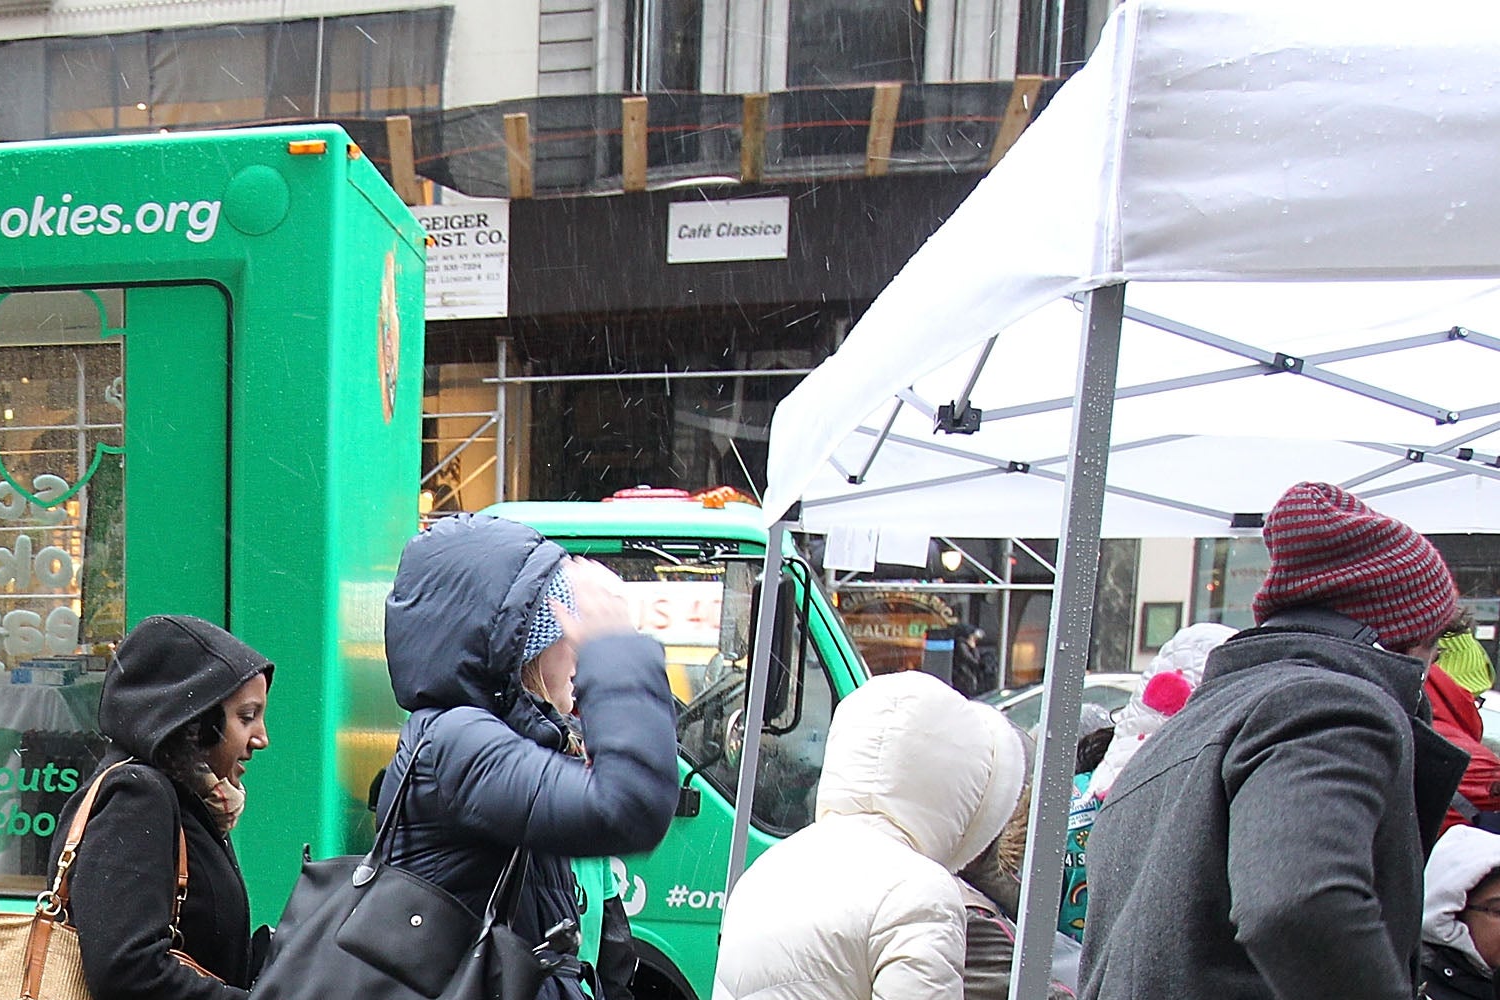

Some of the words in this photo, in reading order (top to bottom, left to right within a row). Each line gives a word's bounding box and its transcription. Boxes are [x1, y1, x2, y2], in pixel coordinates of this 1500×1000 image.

[419, 213, 490, 231] GEIGER
[716, 221, 783, 238] Classico
[475, 229, 507, 246] CO.
[665, 884, 725, 909] #on
